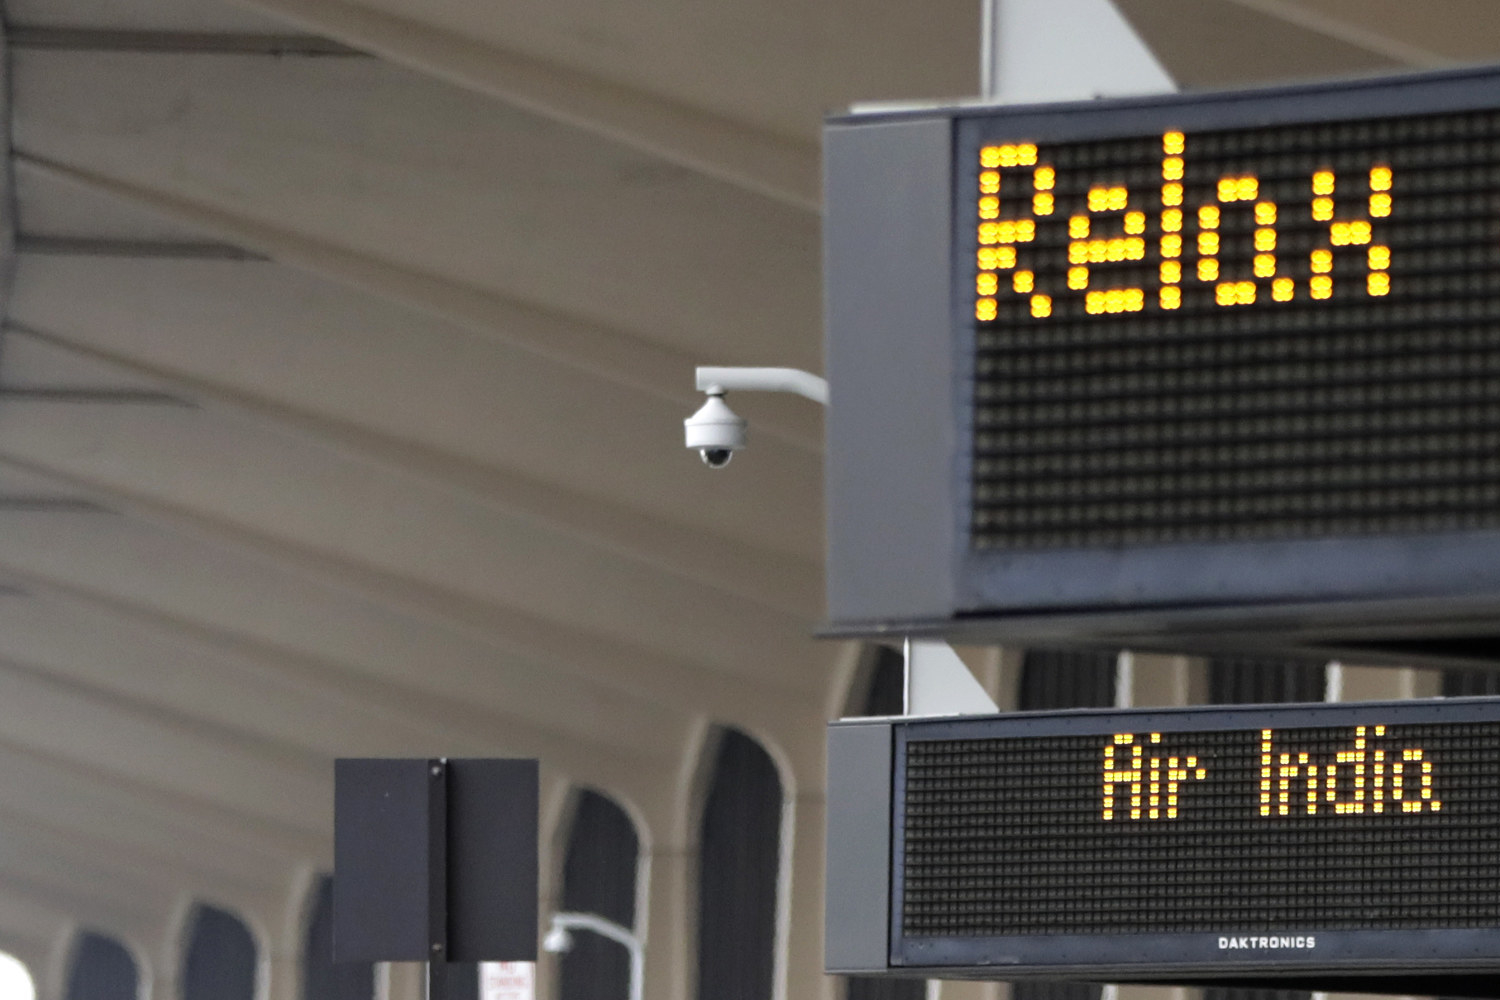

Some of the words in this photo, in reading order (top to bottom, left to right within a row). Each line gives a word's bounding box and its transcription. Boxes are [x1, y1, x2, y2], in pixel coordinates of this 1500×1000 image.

[975, 130, 1393, 321] Relax
[1102, 732, 1206, 820] Air
[1260, 725, 1442, 815] India
[1217, 936, 1317, 950] DAKTRONICS
